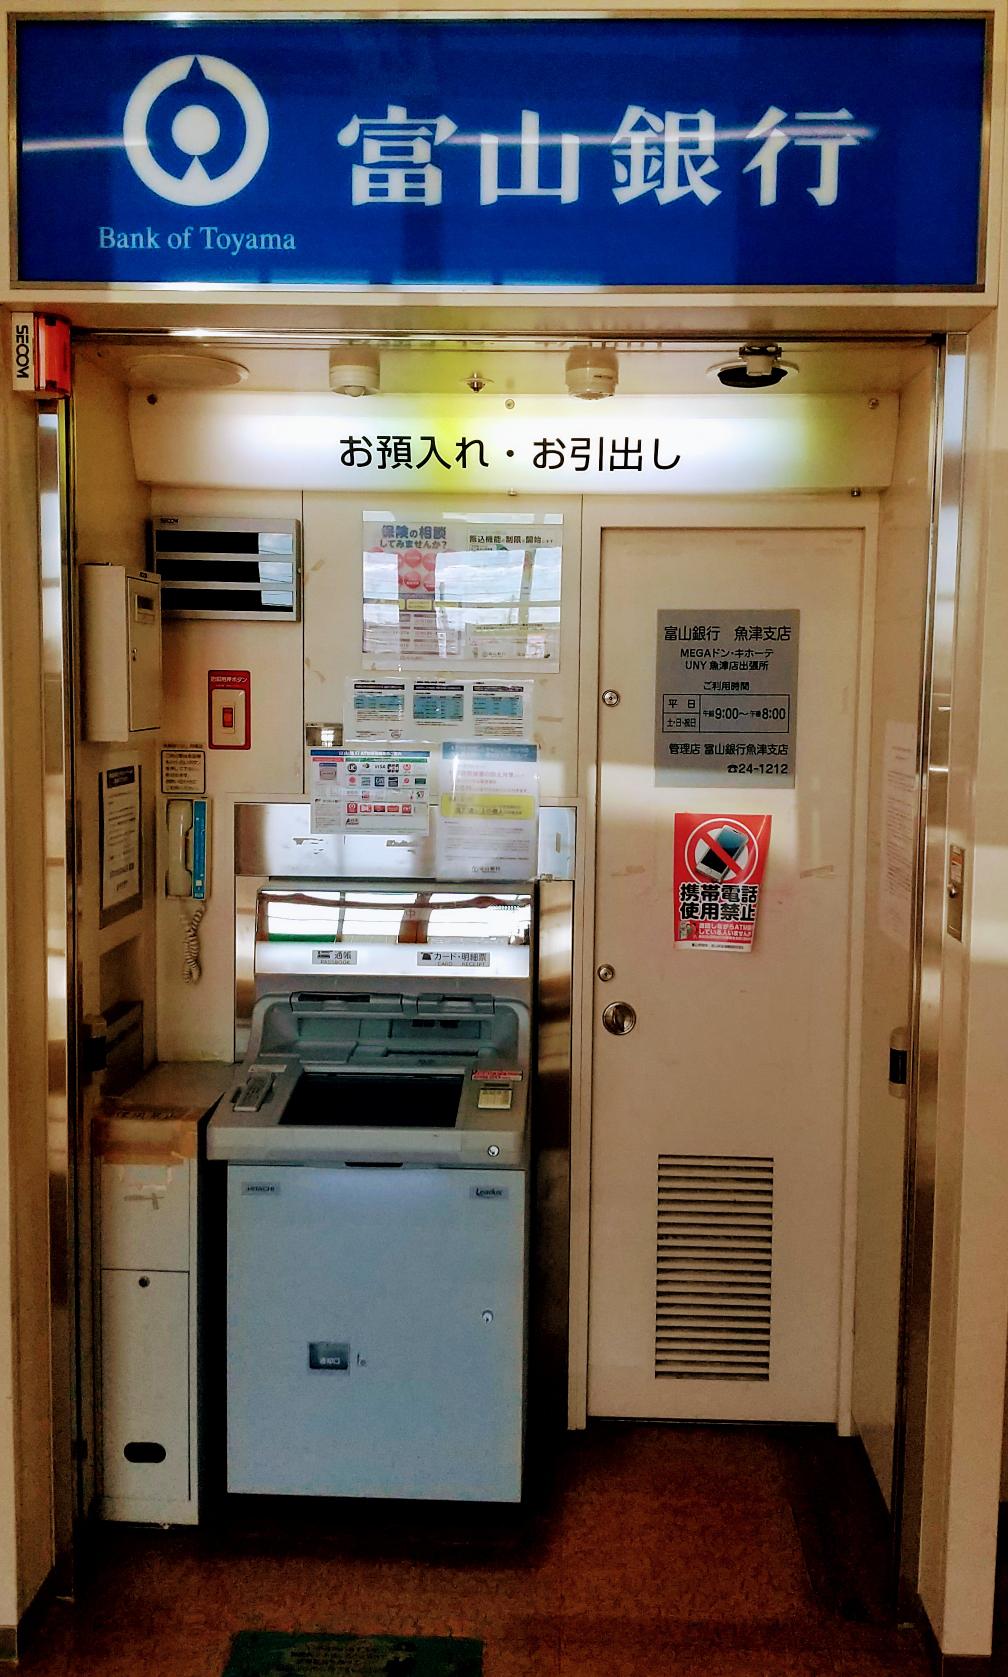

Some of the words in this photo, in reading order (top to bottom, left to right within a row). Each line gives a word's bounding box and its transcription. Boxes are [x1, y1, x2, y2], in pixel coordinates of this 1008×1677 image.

[337, 104, 863, 208] 富山銀行
[98, 226, 160, 251] Bank
[167, 225, 193, 251] of
[199, 226, 297, 257] Toyama
[15, 323, 30, 380] SECOM
[340, 434, 681, 472] お預入れ・お引出し
[382, 524, 447, 539] 保険の相談
[664, 626, 721, 642] 富山銀行
[734, 625, 792, 641] 魚津支店
[680, 648, 774, 658] MEGAドン・キホーテ
[685, 660, 707, 670] UNY
[709, 660, 769, 671] 魚津店出張所
[703, 681, 750, 691] ご利用時間
[669, 742, 701, 755] 管理店
[704, 743, 788, 756] 富山銀行魚津支店
[738, 763, 788, 774] 24-1212
[680, 883, 759, 903] 携帯電話
[680, 903, 755, 922] 使用禁止
[335, 950, 352, 959] 通帳
[434, 952, 487, 961] カード・明細票
